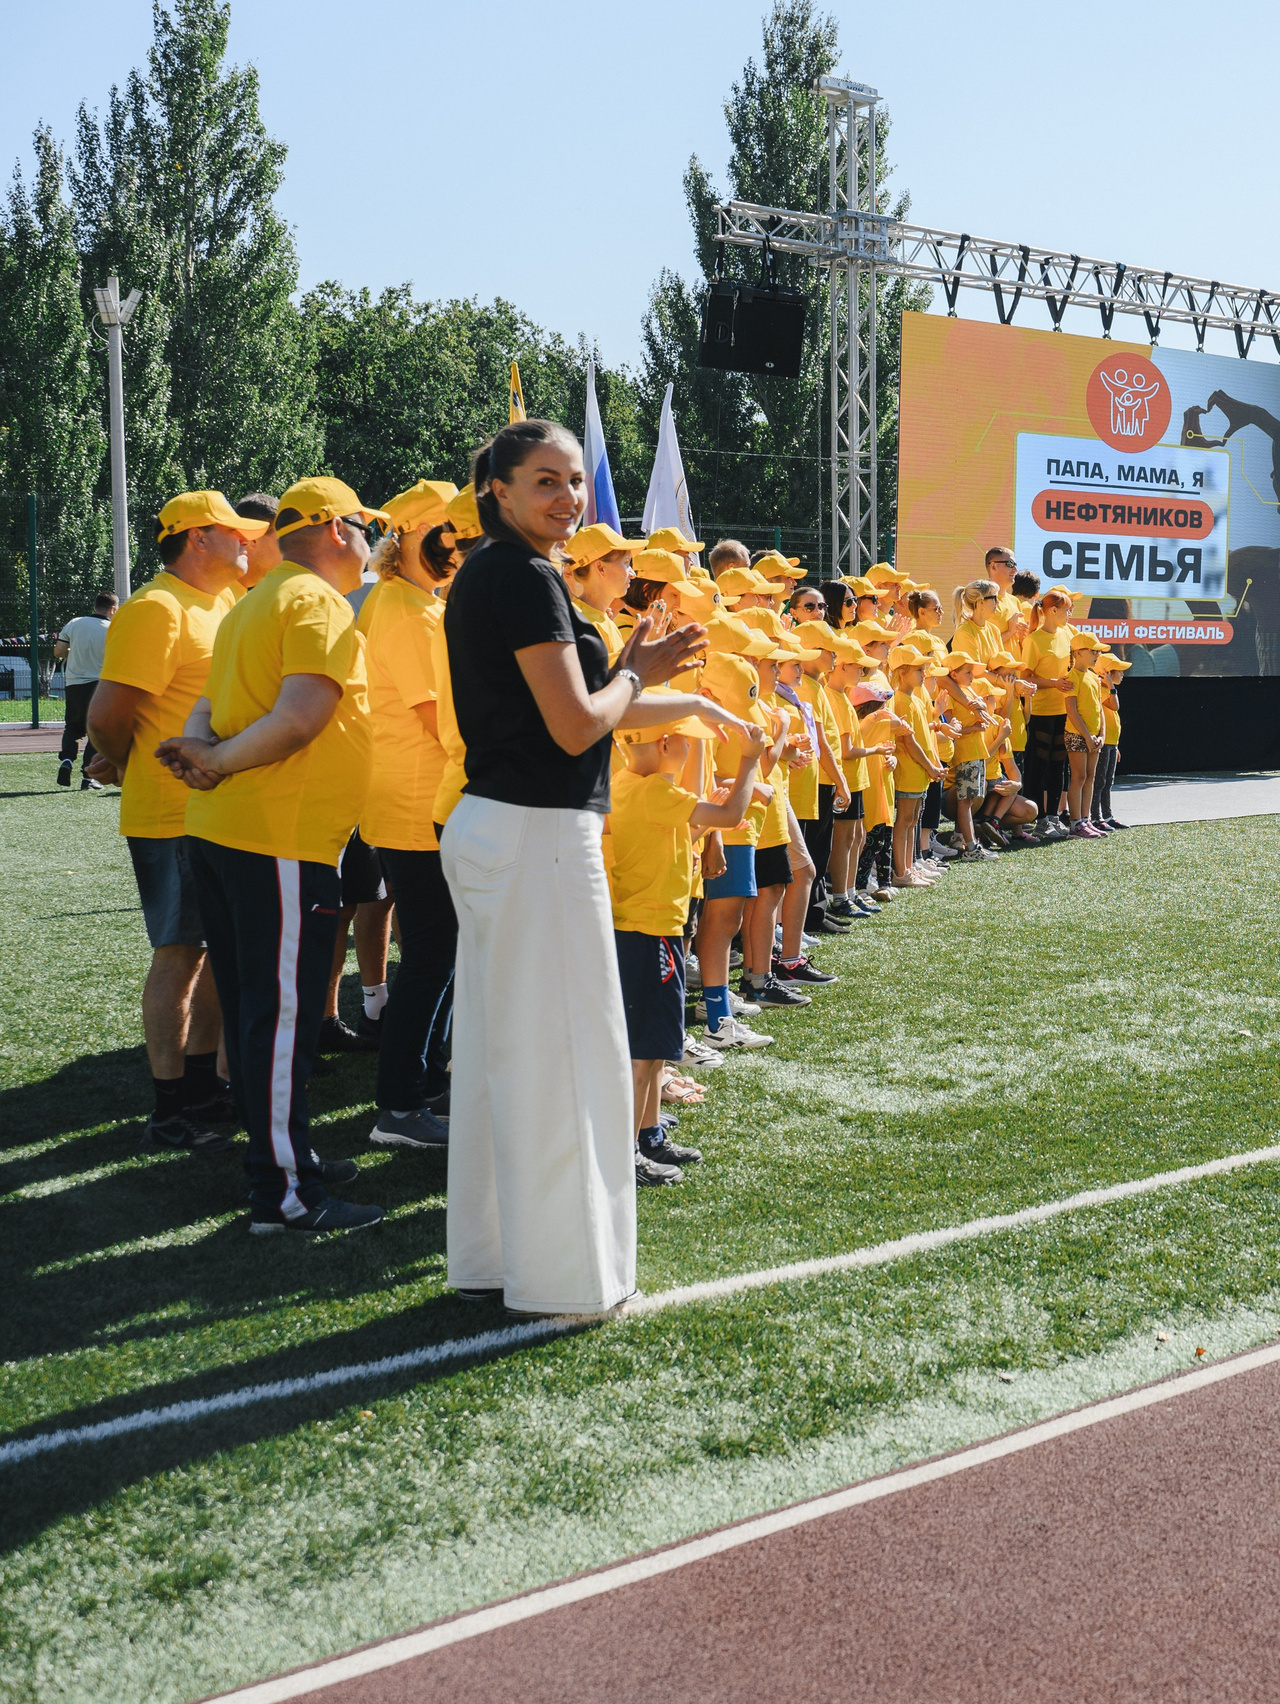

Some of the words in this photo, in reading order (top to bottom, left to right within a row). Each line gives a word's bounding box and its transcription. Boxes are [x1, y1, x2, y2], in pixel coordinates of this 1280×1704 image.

[1046, 458, 1109, 482] ПАПА,
[1117, 464, 1185, 488] МАМА,
[1192, 471, 1204, 488] Я
[1045, 500, 1203, 529] НЕФТЯНИКОВ
[1042, 540, 1203, 584] СЕМЬЯ
[1134, 625, 1225, 640] ФЕСТИВАЛЬ
